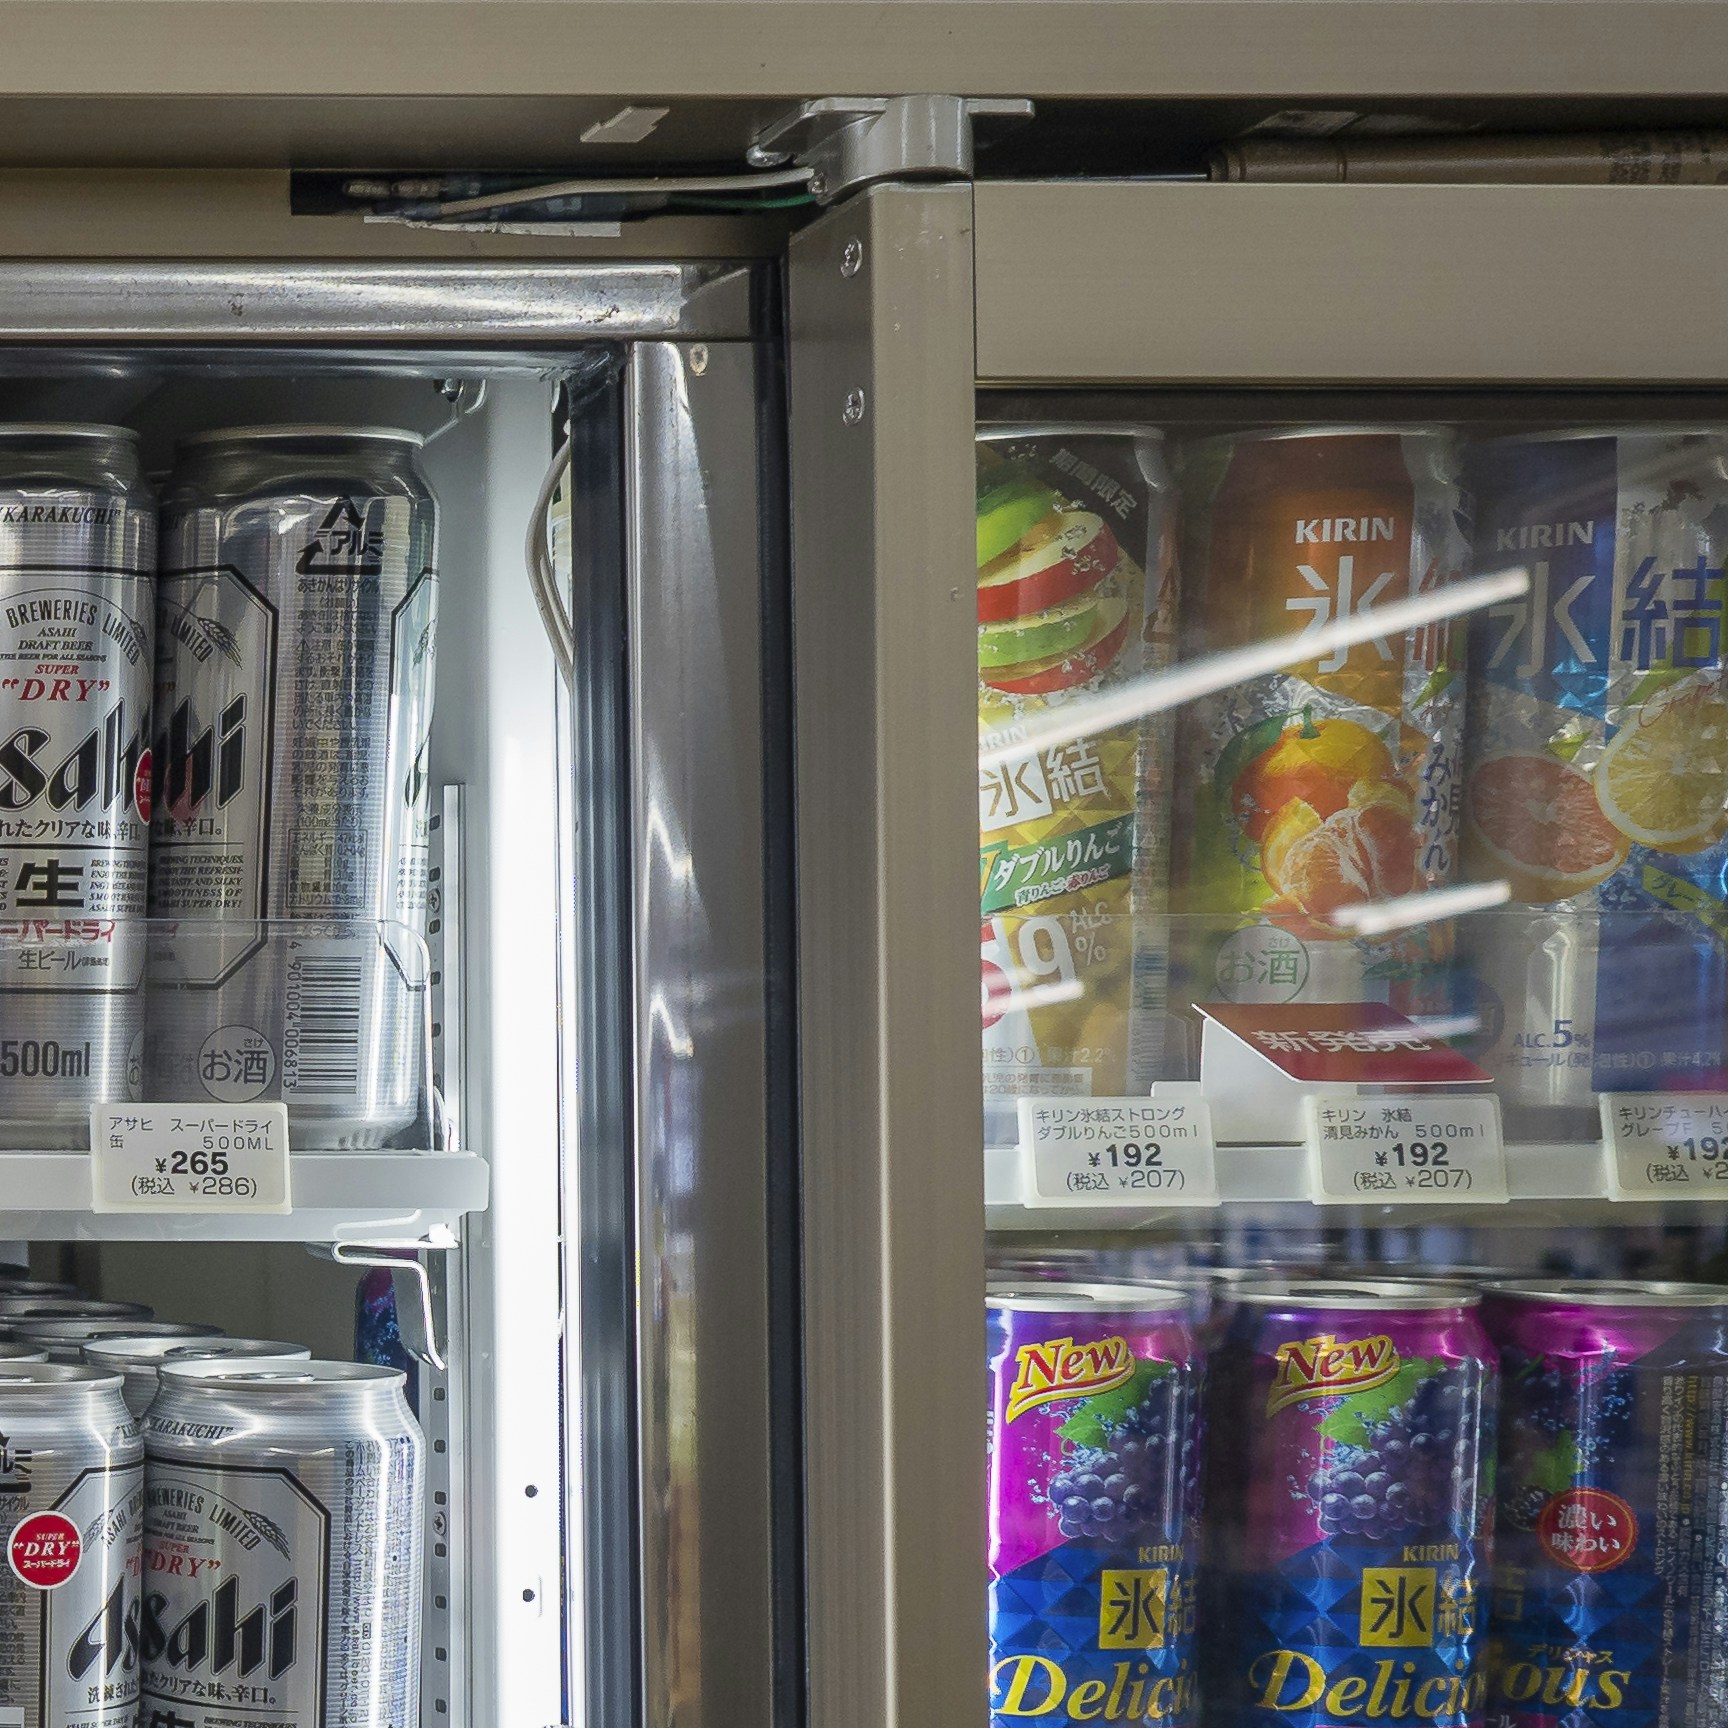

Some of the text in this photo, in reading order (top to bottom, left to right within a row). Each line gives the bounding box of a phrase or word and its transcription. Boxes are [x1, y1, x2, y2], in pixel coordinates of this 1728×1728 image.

[1294, 516, 1396, 546] KIRIN
[1496, 520, 1594, 552] KIRIN
[1286, 555, 1396, 673] 氷
[6, 600, 100, 630] BREWERIES
[102, 618, 142, 668] LIMITED
[14, 860, 84, 908] 生
[1220, 948, 1302, 986] お酒
[1250, 1026, 1434, 1056] 新発売
[0, 1040, 90, 1078] 500ml
[202, 1050, 270, 1084] お酒
[108, 1116, 273, 1134] アサヒ スーパードライ
[1321, 1107, 1413, 1124] キリン 氷結
[154, 1150, 229, 1176] ¥265
[1087, 1142, 1163, 1168] ¥192
[1374, 1141, 1450, 1167] ¥192
[1020, 1338, 1132, 1386] New
[1284, 1338, 1394, 1384] New
[1402, 1544, 1460, 1564] KIRIN
[1550, 1534, 1622, 1554] 味わい
[1368, 1580, 1430, 1640] 氷
